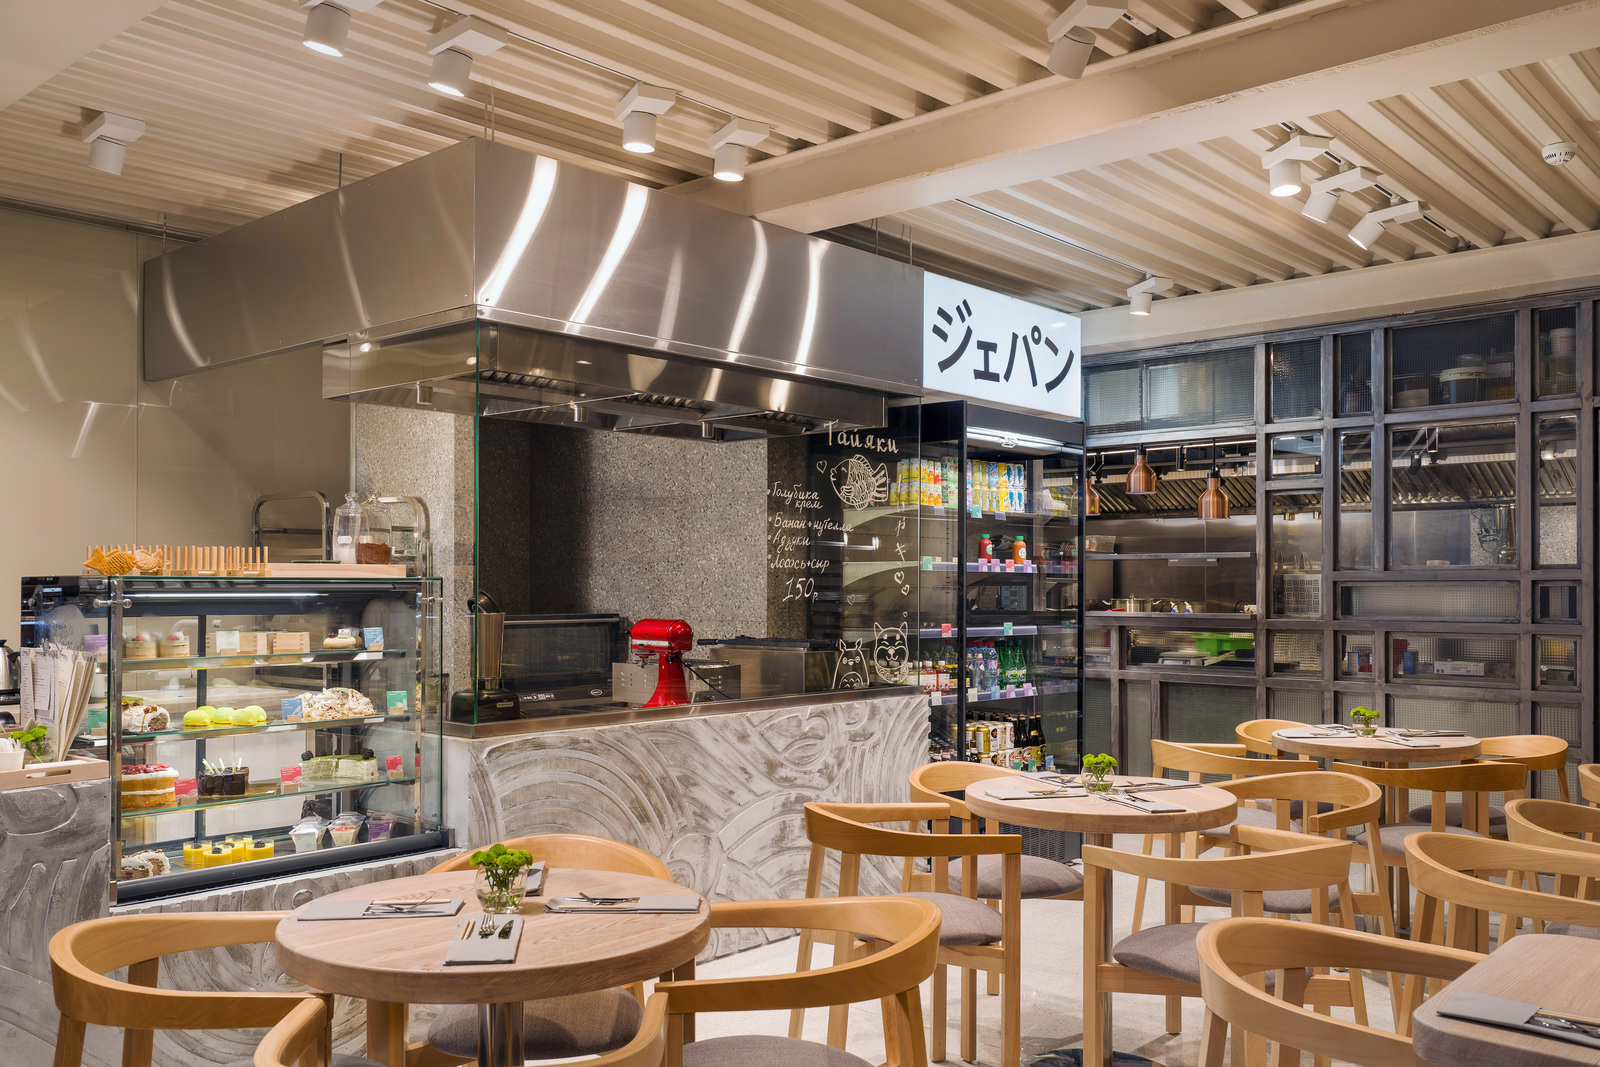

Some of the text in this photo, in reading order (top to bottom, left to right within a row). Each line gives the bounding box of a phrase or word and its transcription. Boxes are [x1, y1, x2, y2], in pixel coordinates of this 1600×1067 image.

[932, 299, 1074, 393] ジェパン
[824, 419, 899, 453] Тайяки
[772, 481, 820, 505] Голубика
[795, 500, 823, 513] крем
[773, 529, 811, 553] Адзуки
